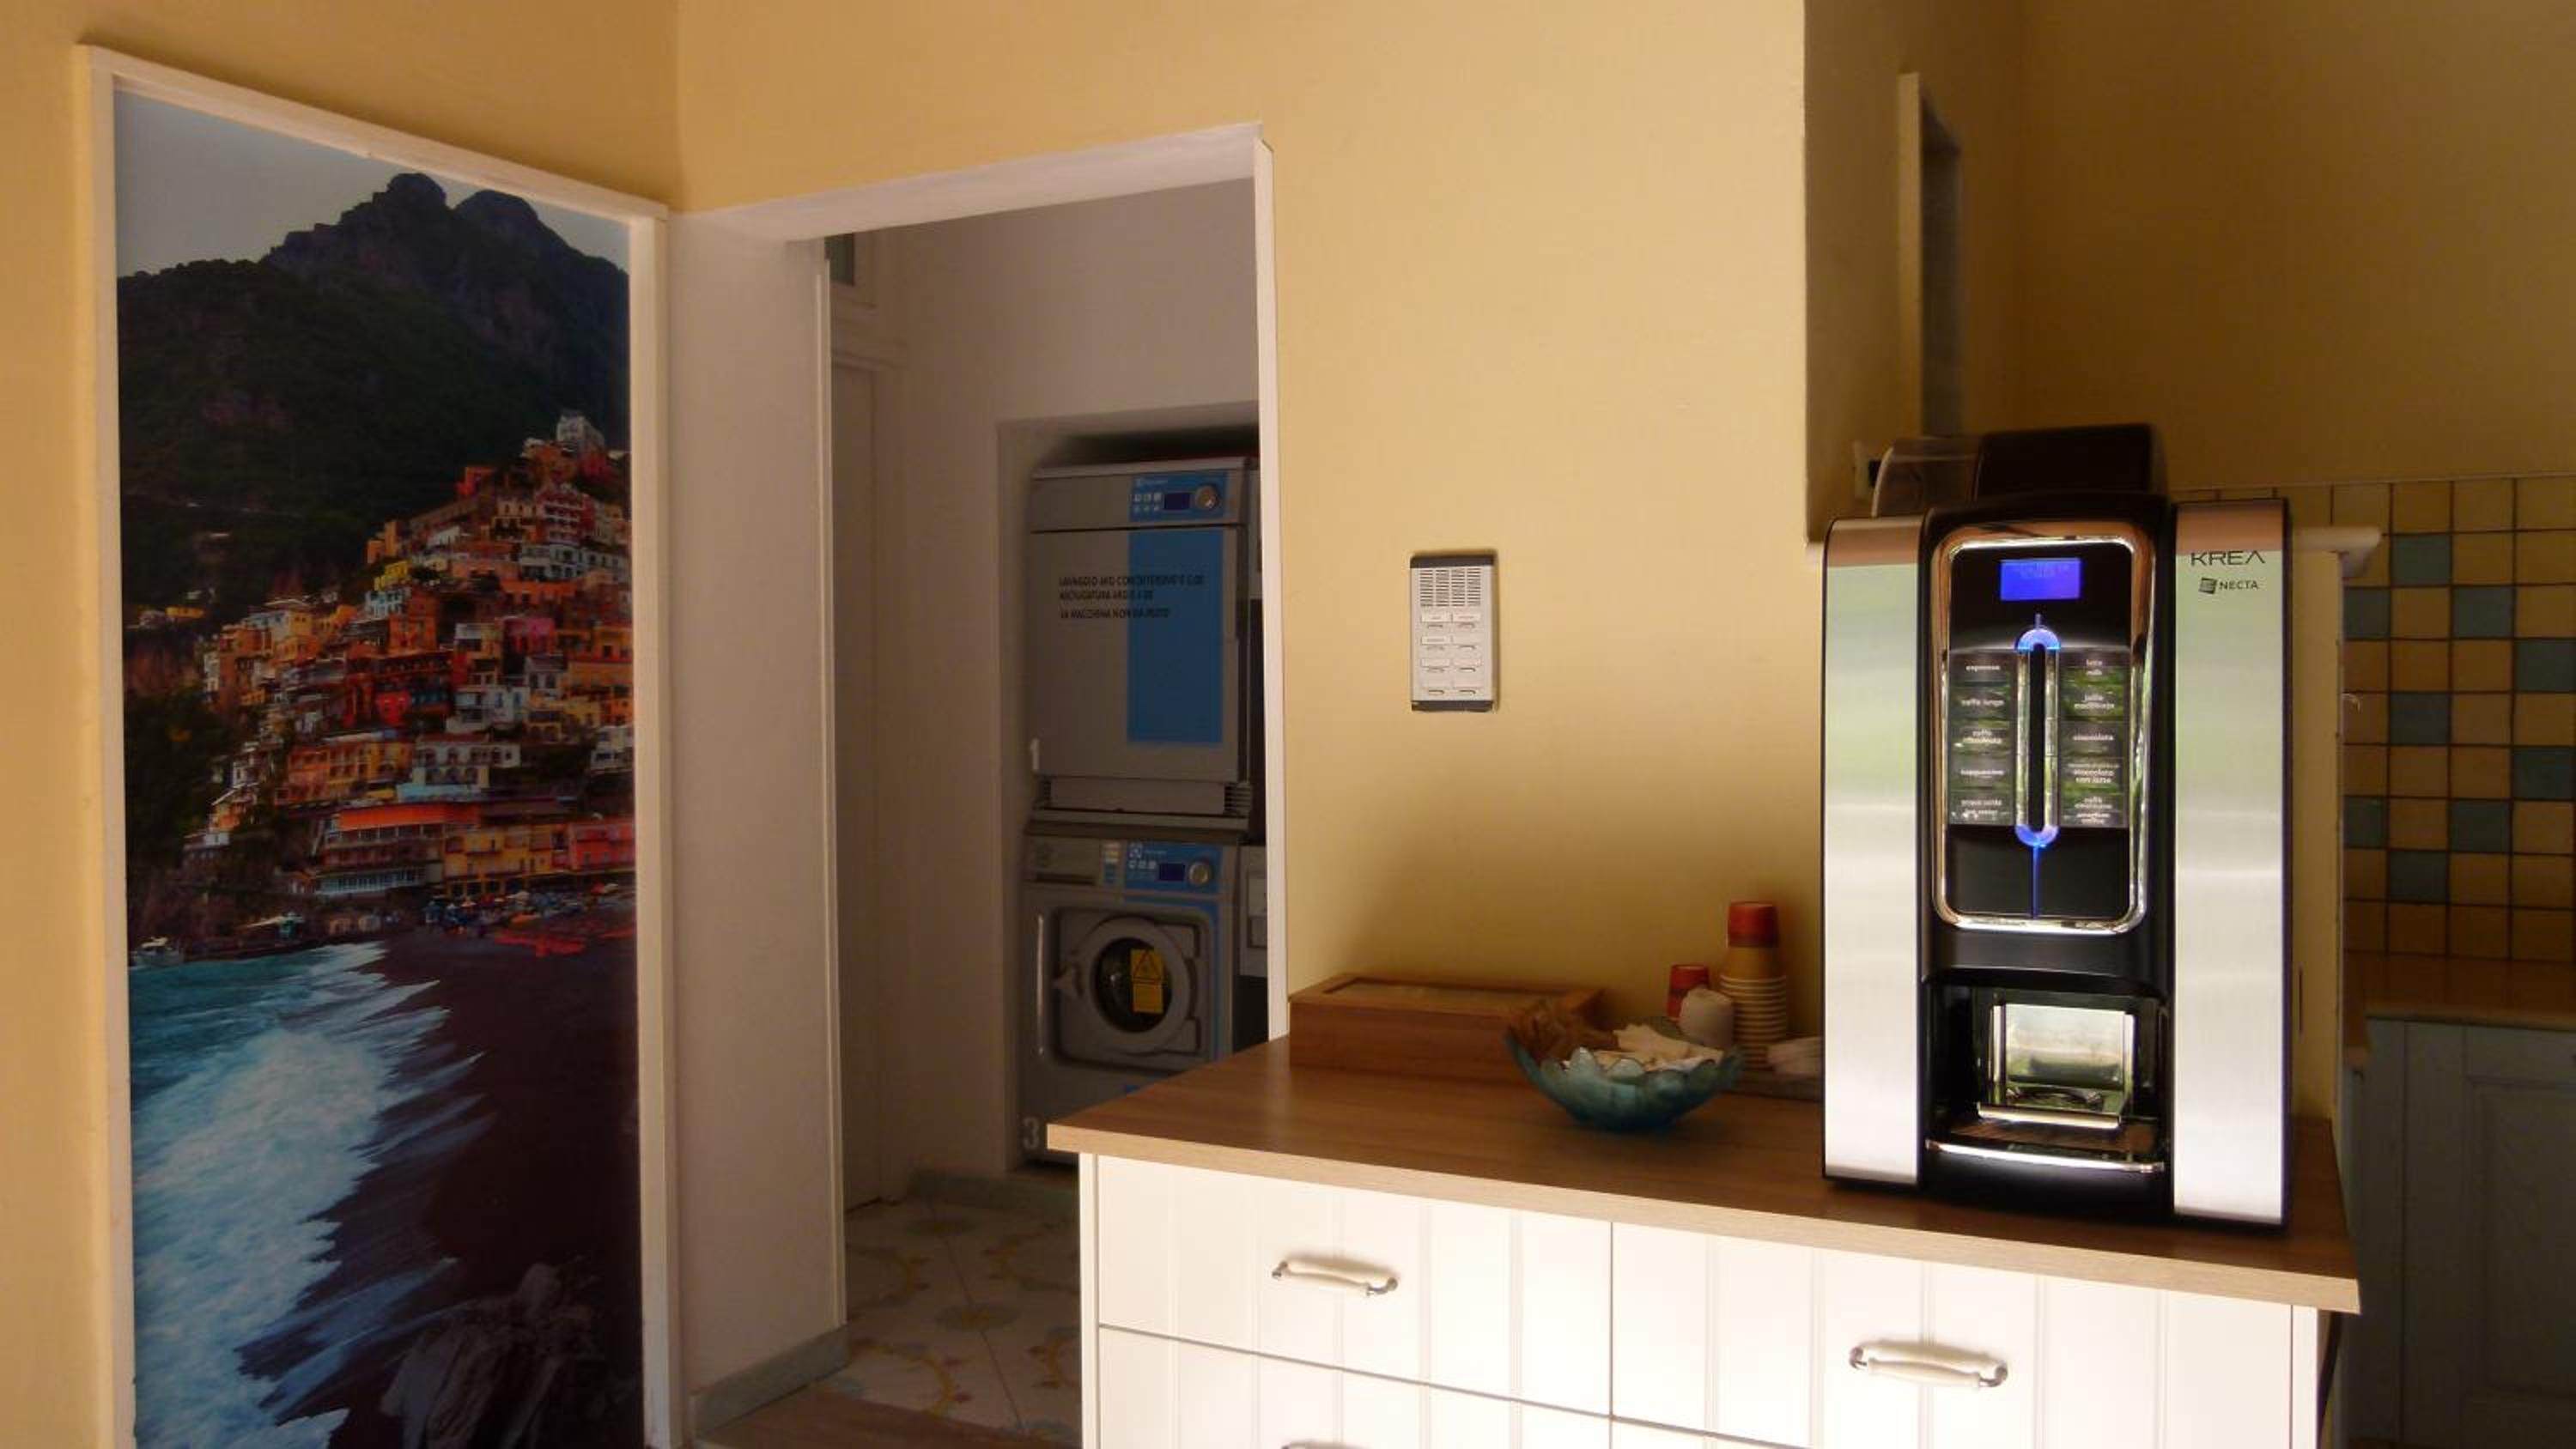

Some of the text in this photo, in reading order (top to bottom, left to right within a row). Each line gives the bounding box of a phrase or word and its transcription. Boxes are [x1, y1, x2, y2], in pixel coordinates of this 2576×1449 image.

[2190, 550, 2266, 567] KREA
[2219, 580, 2258, 591] NECTA
[1023, 1116, 1040, 1150] 3
